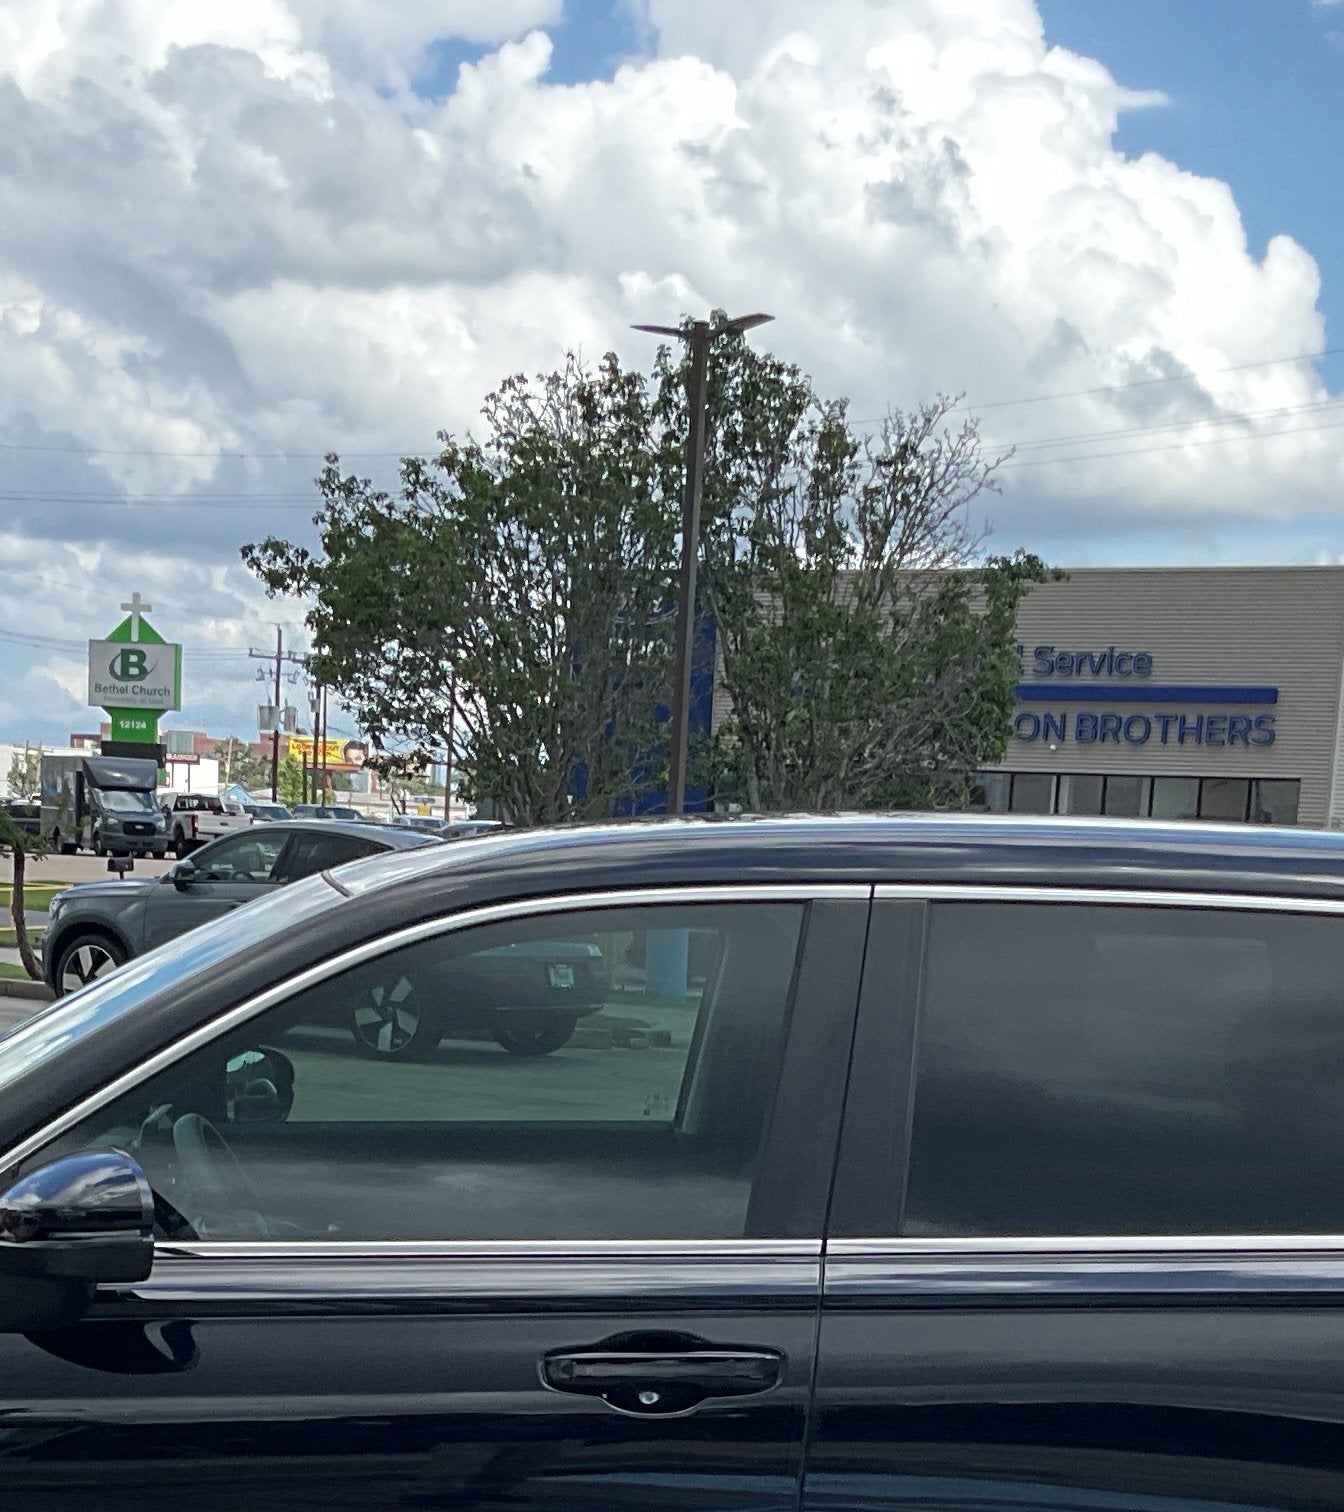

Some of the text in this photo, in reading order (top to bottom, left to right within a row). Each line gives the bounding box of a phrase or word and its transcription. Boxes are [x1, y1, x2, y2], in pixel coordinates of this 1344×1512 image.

[1032, 645, 1153, 677] Service
[94, 683, 171, 697] Bethel Church
[1074, 713, 1277, 747] BROTHERS
